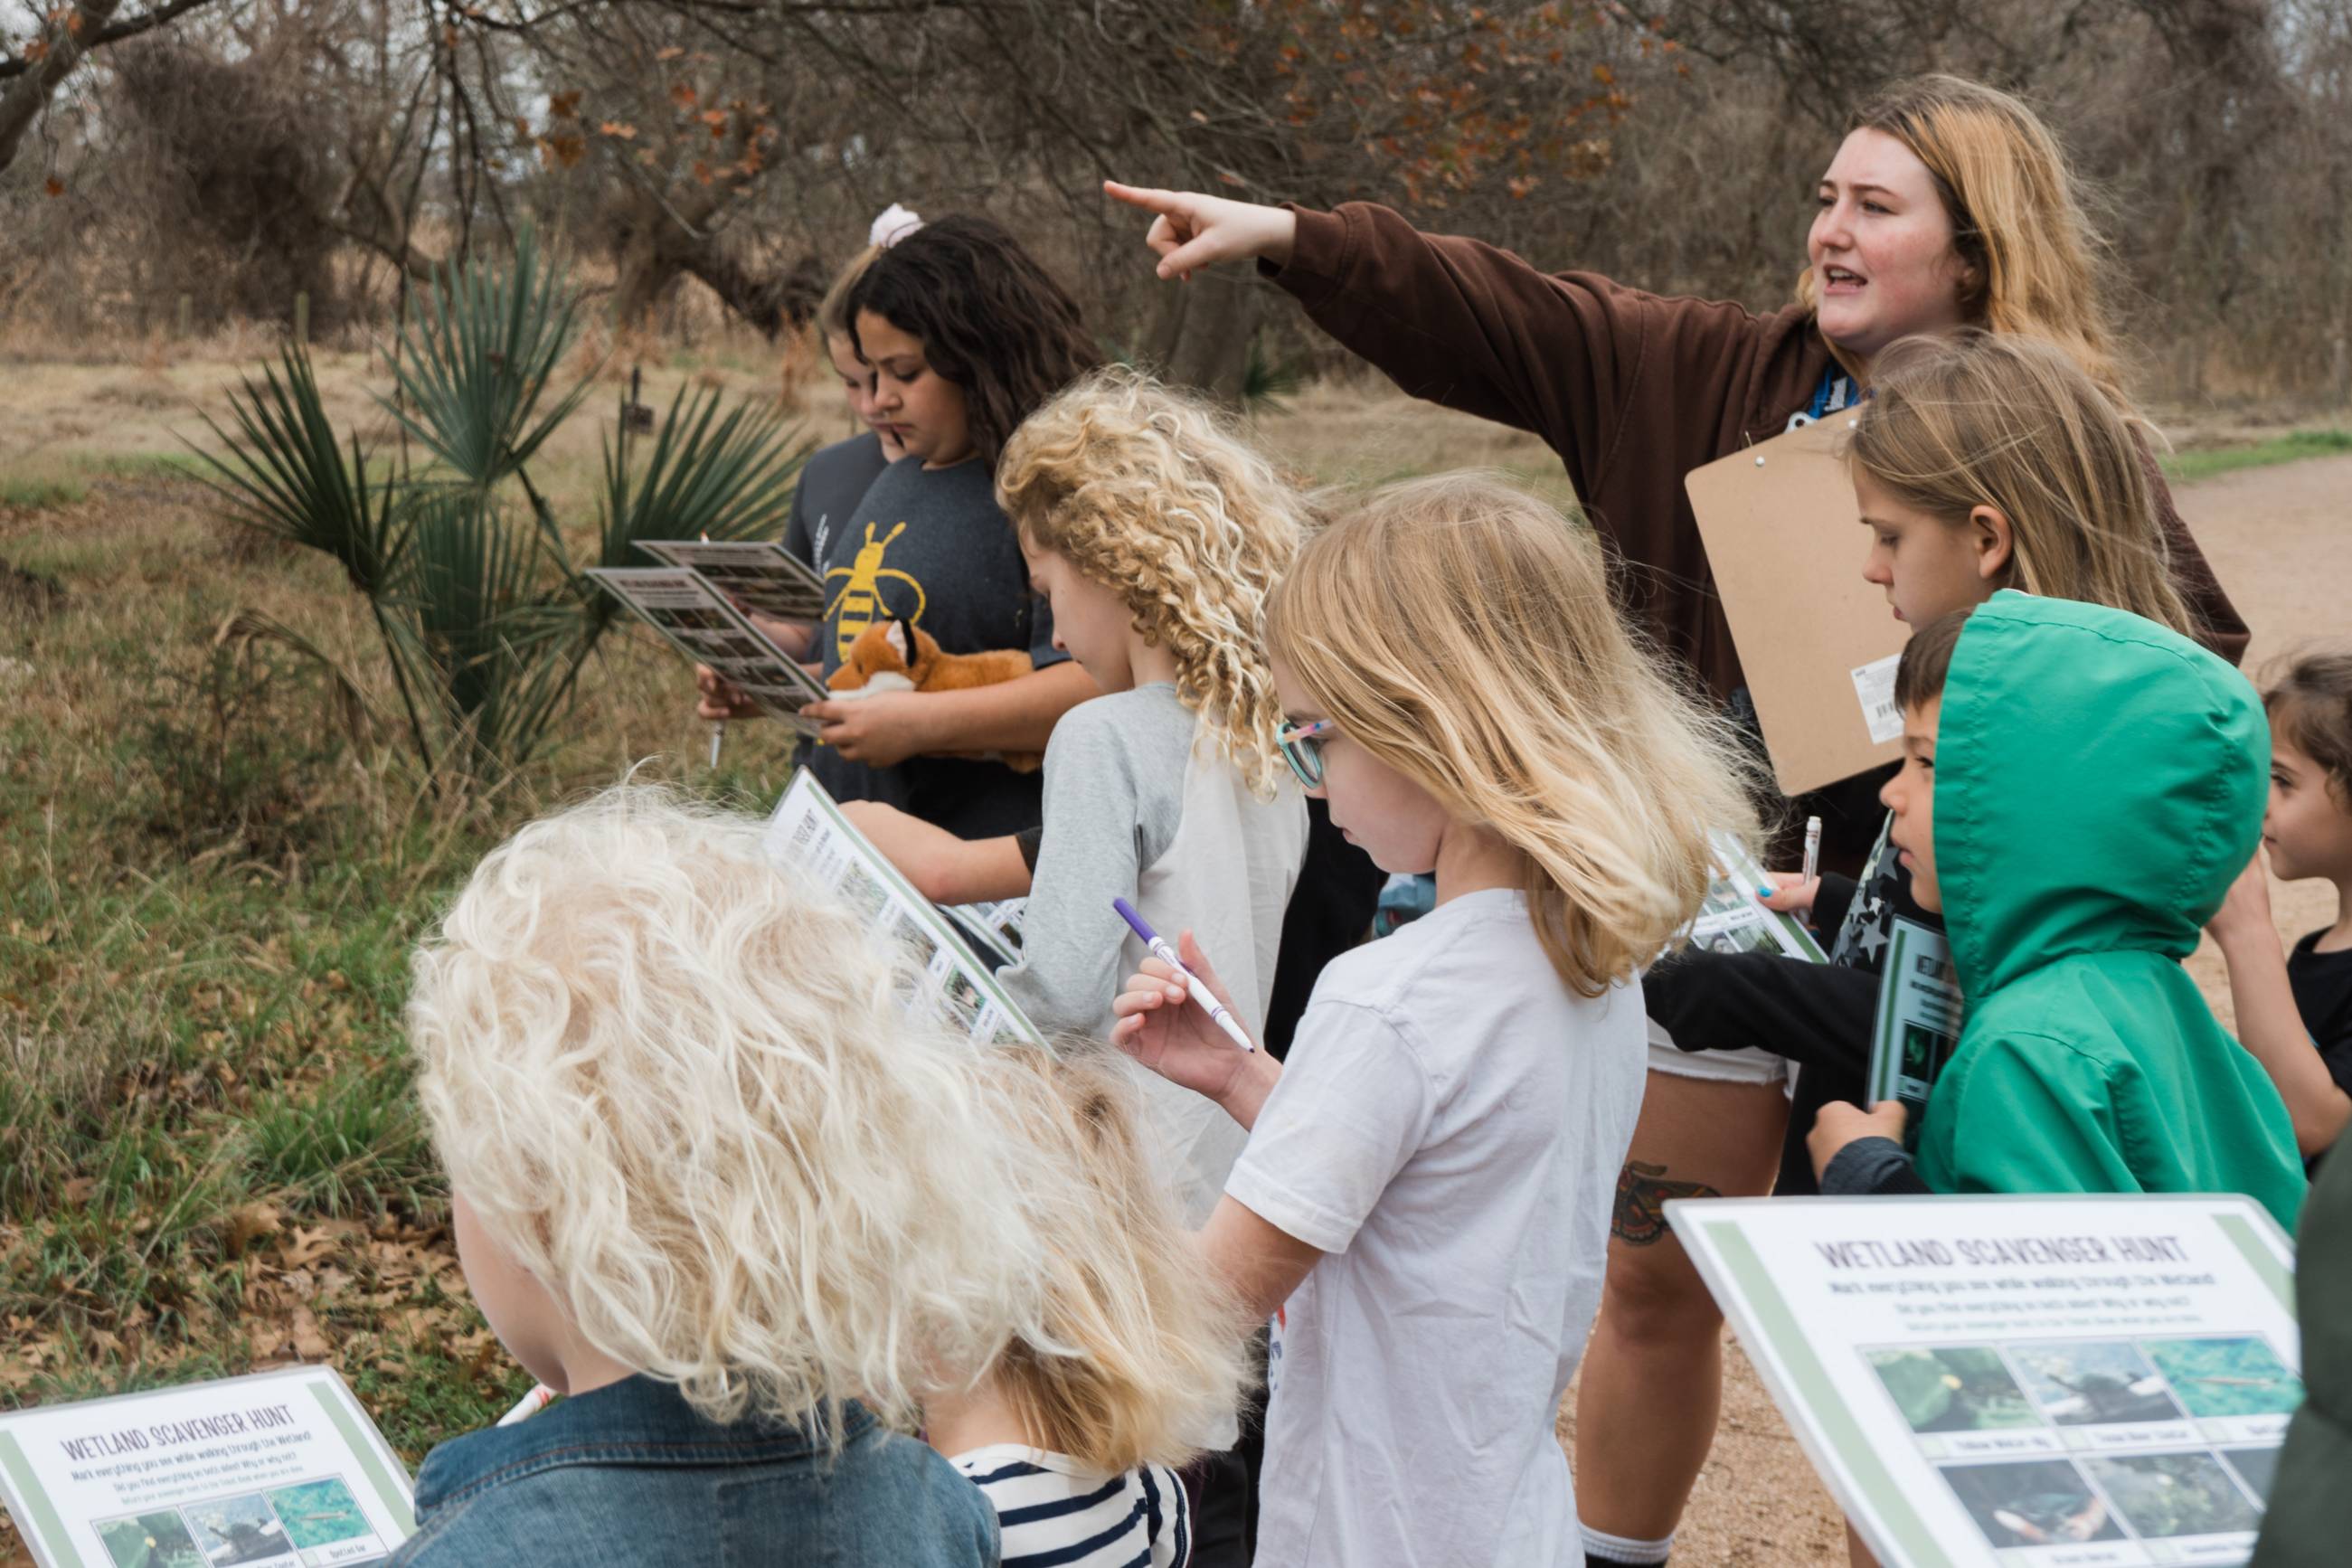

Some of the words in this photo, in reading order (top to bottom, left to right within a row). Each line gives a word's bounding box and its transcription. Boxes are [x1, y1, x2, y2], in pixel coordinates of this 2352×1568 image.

[1813, 1240, 1953, 1268] WETLAND
[1955, 1237, 2116, 1265] SCAVENGER
[2110, 1235, 2189, 1262] HUNT
[60, 1429, 149, 1460] WETLAND
[149, 1412, 250, 1446] SCAVENGER
[246, 1404, 295, 1430] HUNT
[95, 1461, 142, 1477] everything
[142, 1459, 158, 1471] you
